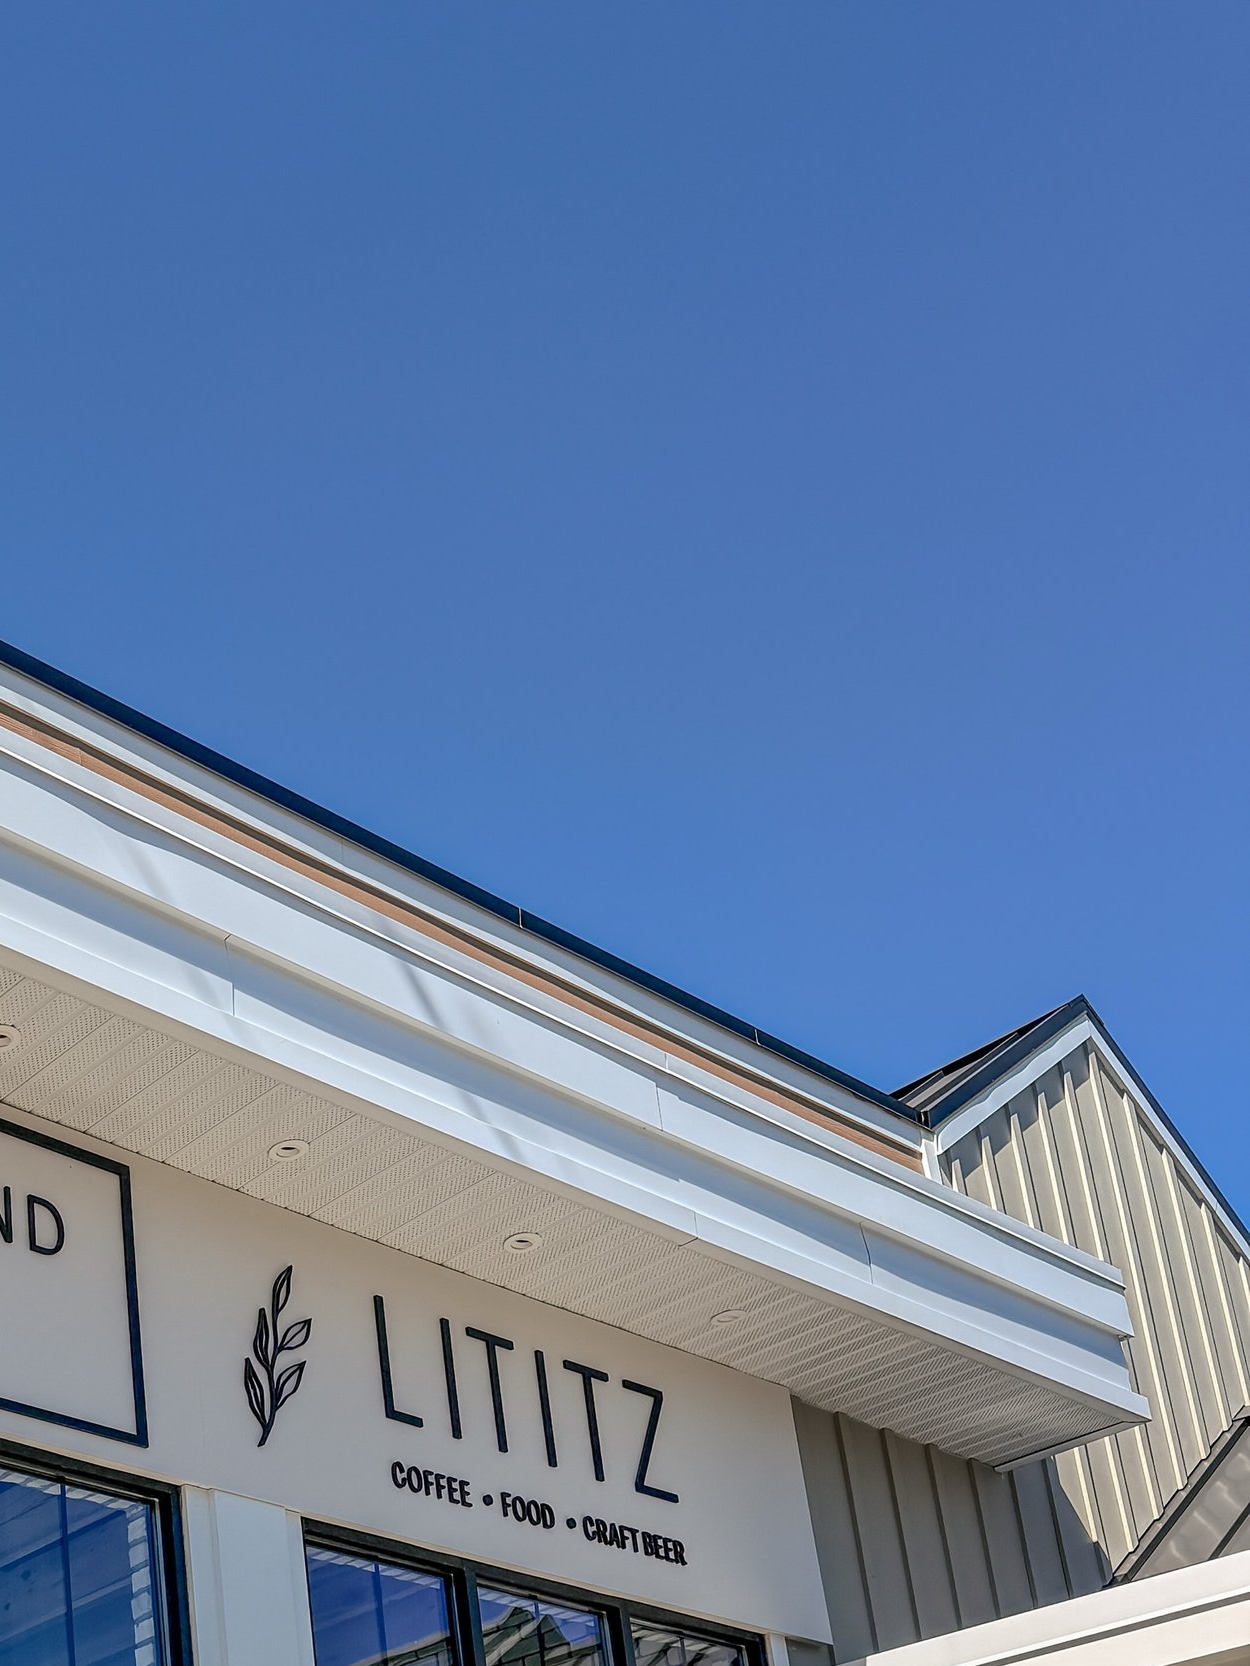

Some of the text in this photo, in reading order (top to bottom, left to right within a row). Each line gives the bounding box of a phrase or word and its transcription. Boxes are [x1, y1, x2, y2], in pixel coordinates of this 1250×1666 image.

[373, 1294, 680, 1503] LITITZ
[391, 1460, 689, 1567] COFFEE FOOD CRAFT BEER
